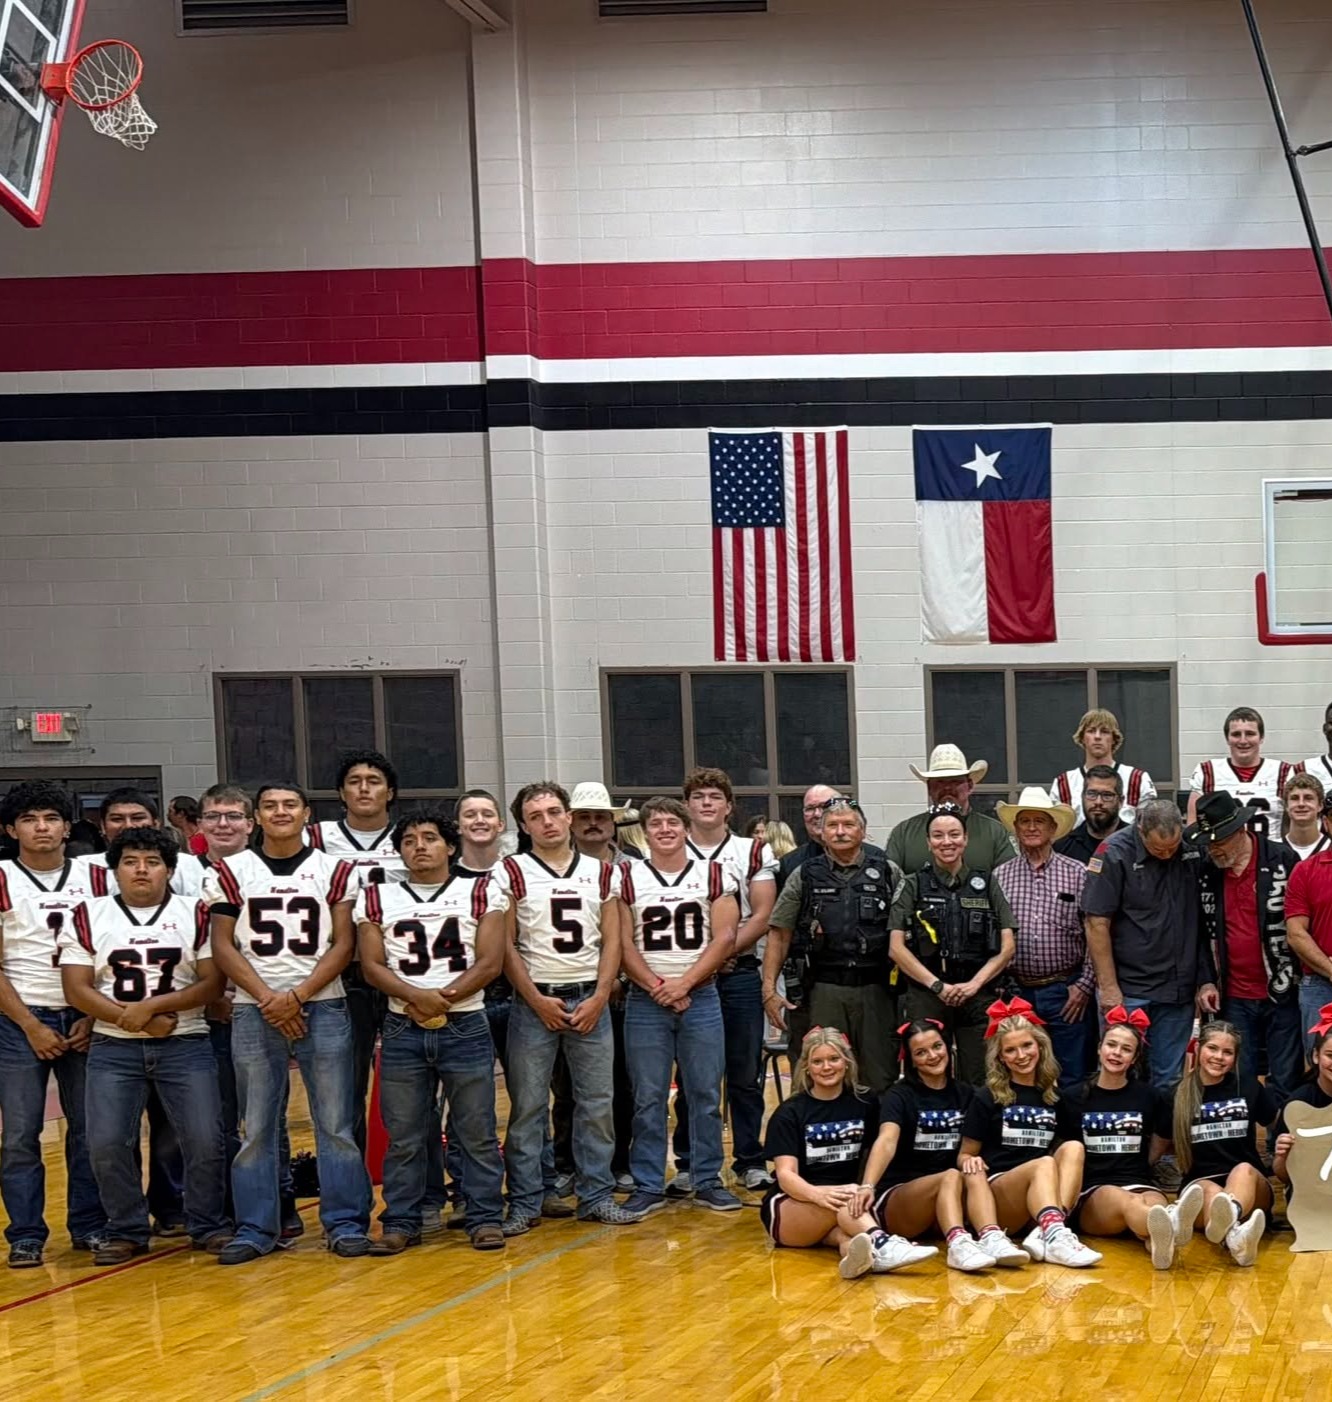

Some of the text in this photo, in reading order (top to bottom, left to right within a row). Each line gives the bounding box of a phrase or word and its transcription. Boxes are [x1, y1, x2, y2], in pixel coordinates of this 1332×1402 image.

[248, 896, 320, 956] 53
[394, 917, 467, 976] 34
[550, 898, 584, 953] 5
[642, 902, 704, 951] 20
[107, 947, 184, 1002] 67
